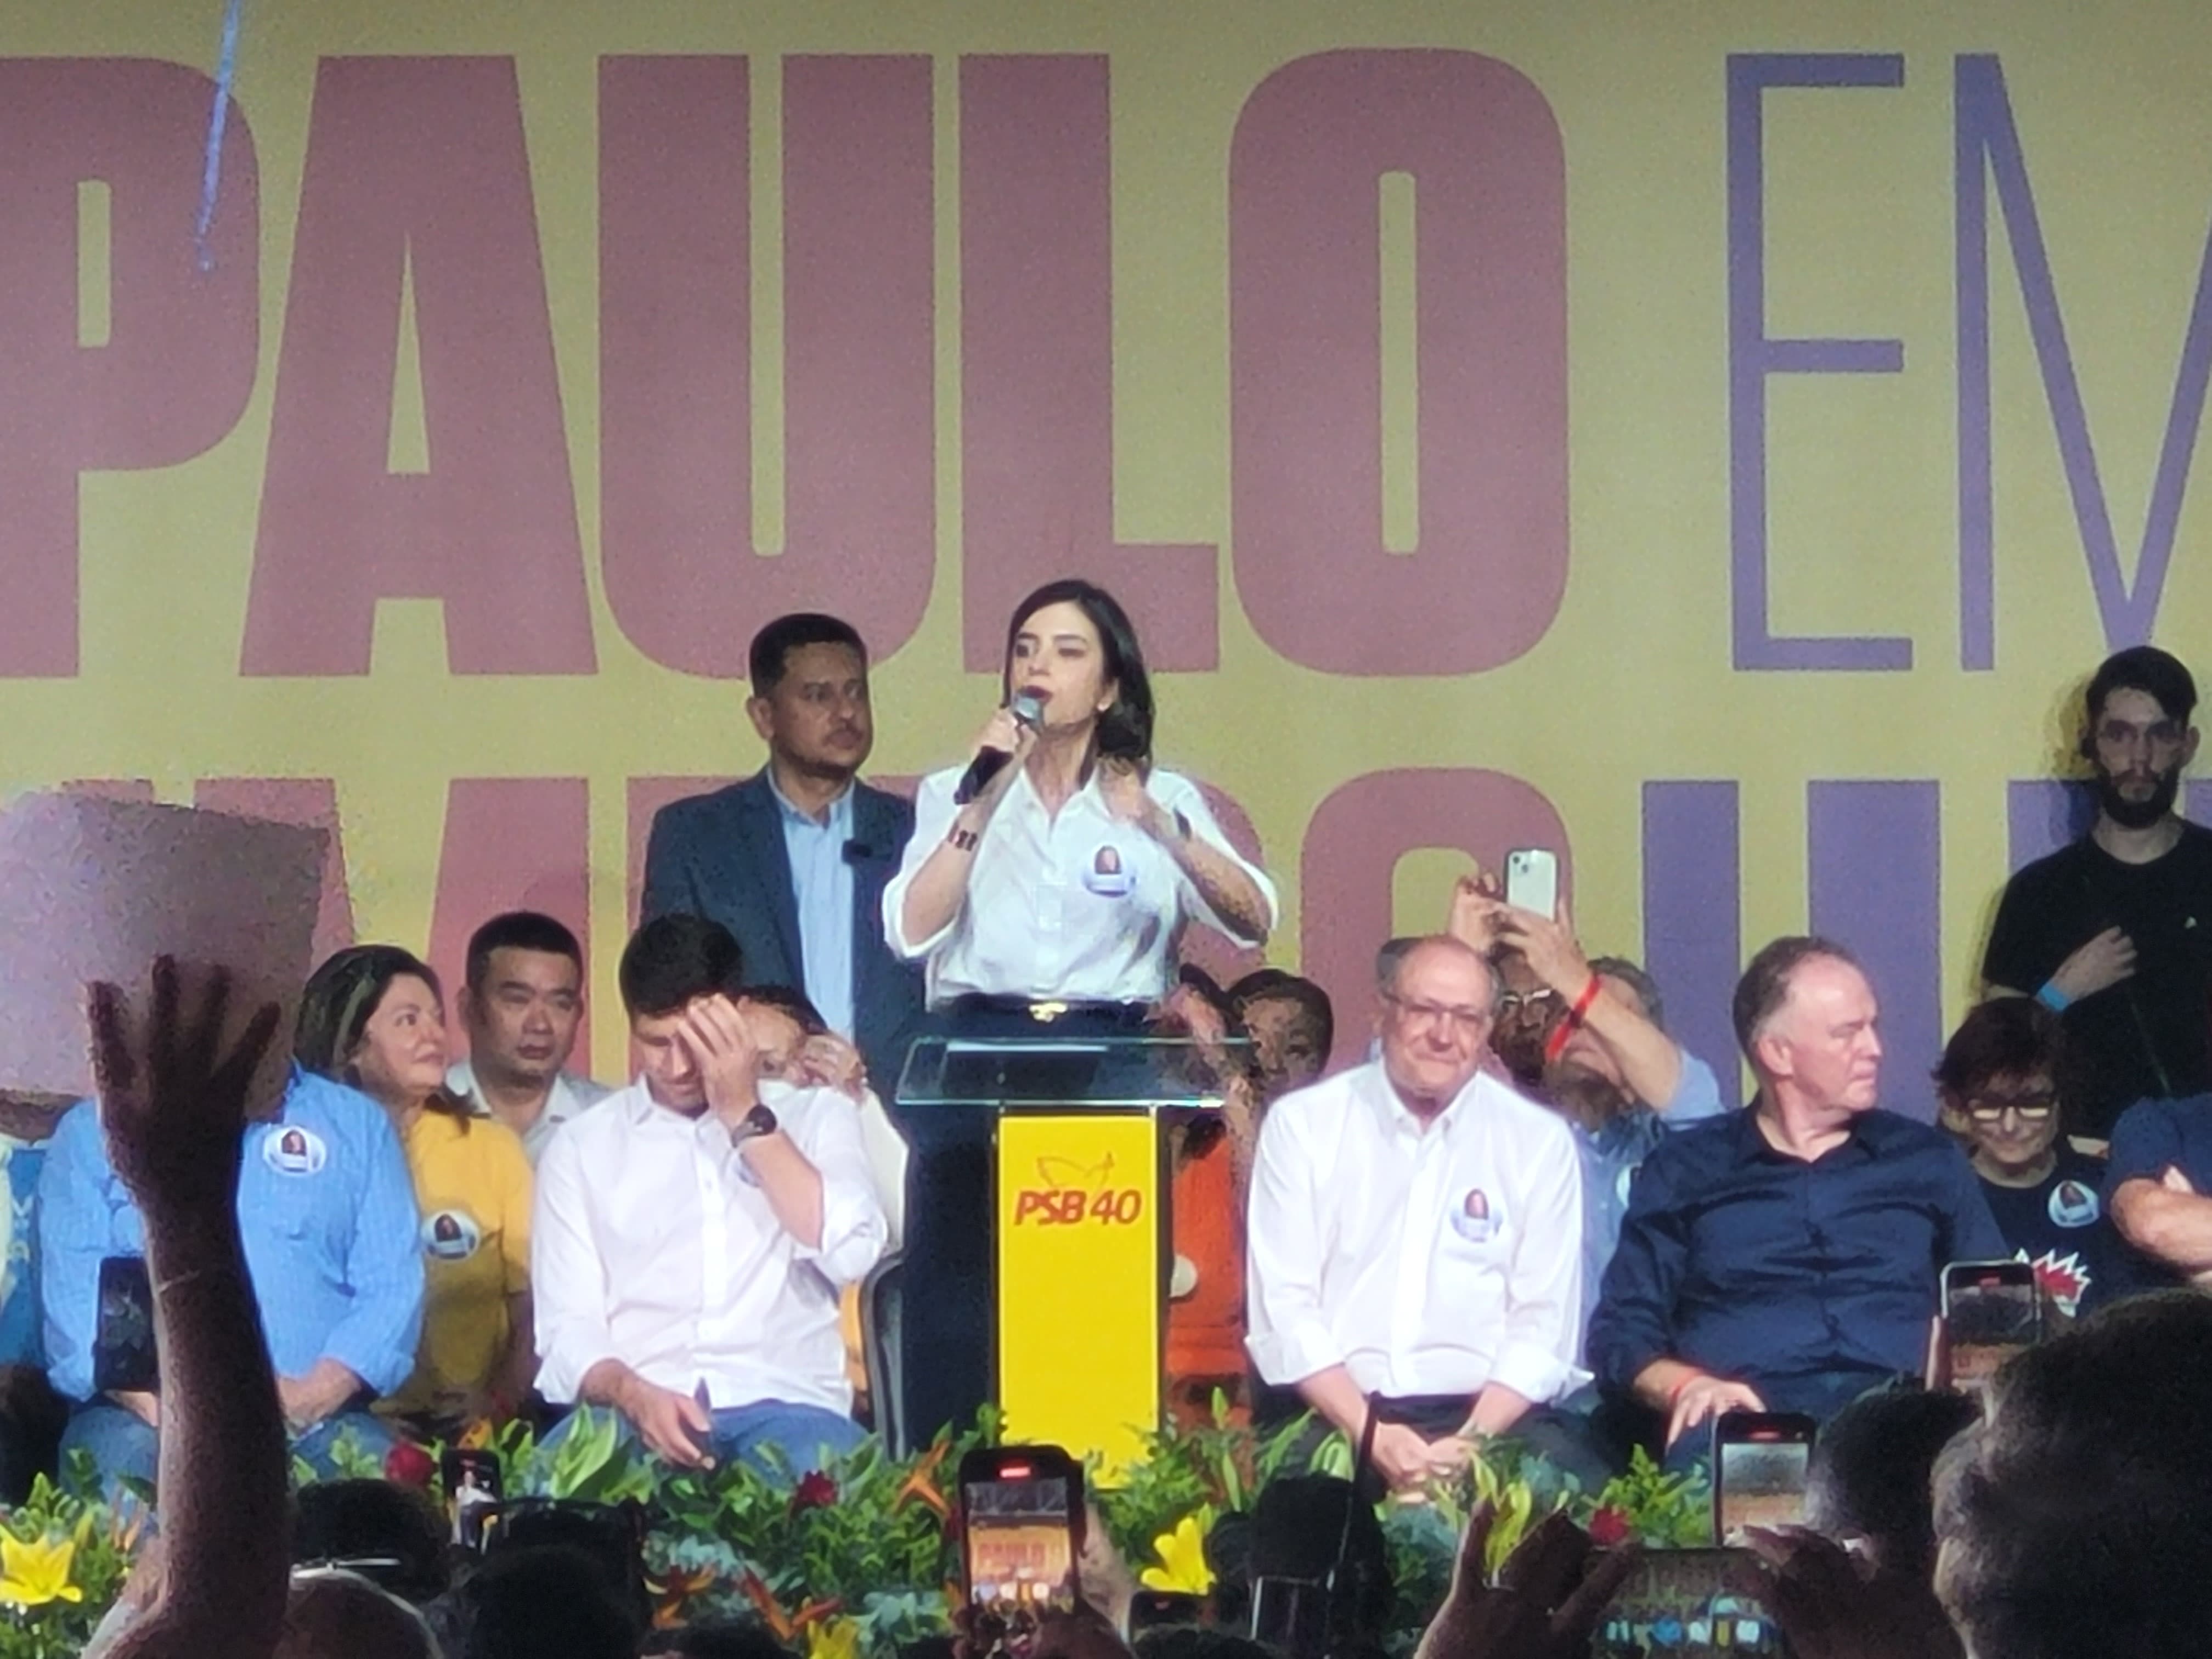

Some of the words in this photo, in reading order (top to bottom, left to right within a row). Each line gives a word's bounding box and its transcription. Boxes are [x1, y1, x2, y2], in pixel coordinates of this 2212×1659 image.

[0, 47, 1568, 677] PAULO
[1014, 1189, 1087, 1226] PSB
[1090, 1189, 1142, 1226] 40
